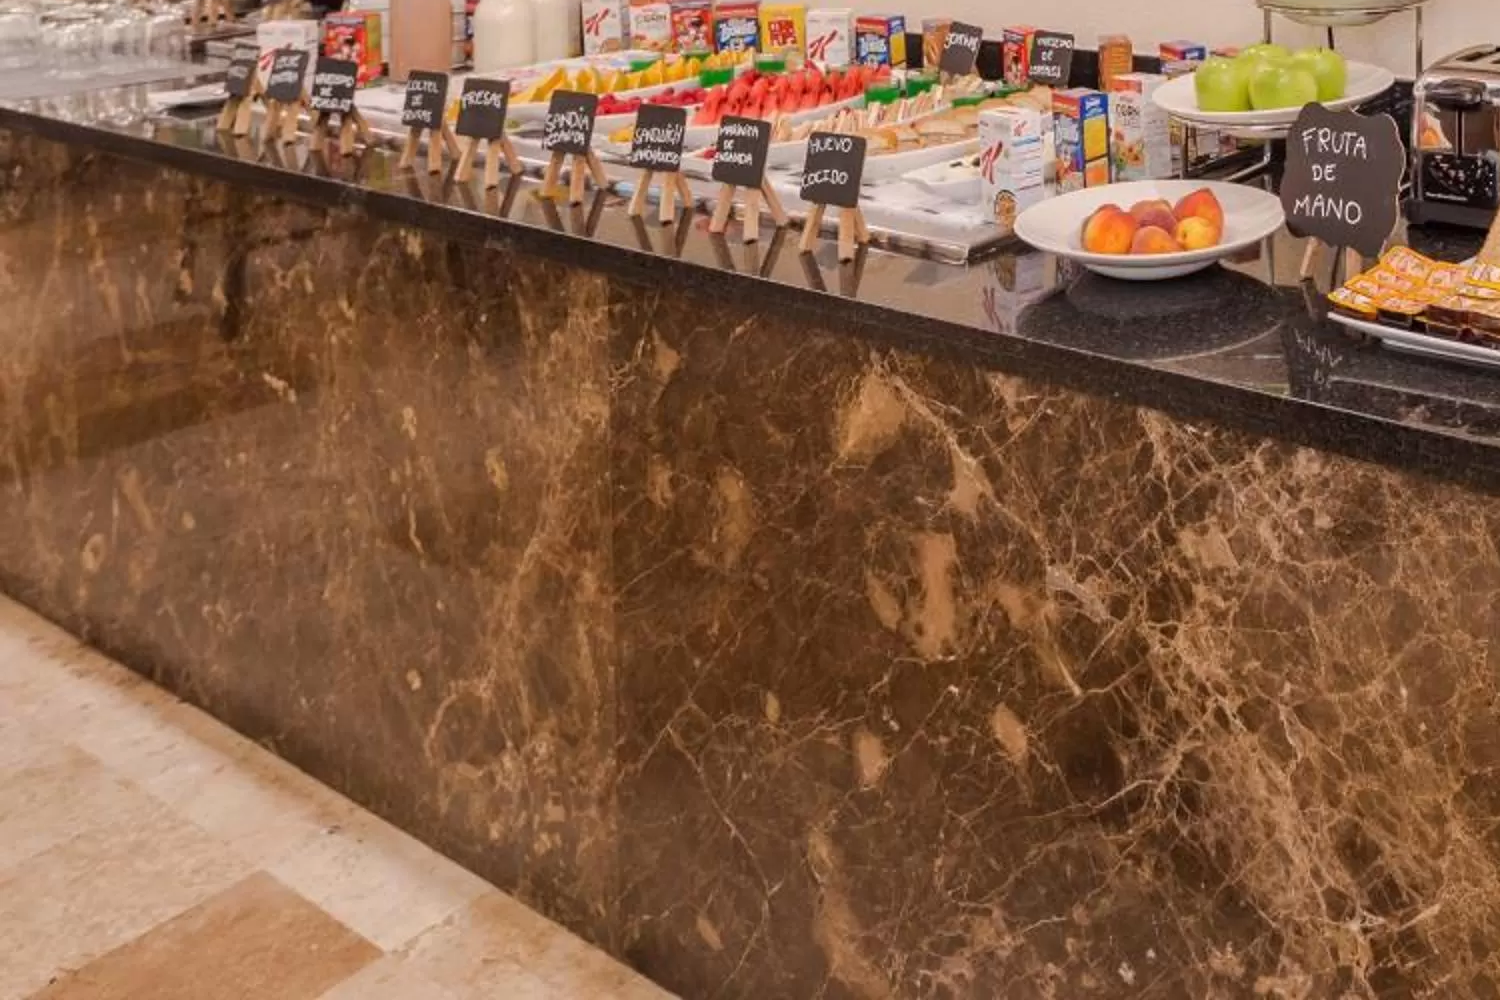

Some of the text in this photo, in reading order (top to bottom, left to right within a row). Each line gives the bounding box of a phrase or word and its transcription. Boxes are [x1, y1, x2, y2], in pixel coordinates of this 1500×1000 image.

[809, 137, 853, 155] HUEVO
[1301, 127, 1367, 160] FRUTA
[801, 169, 849, 188] COCIDO
[1311, 163, 1338, 181] DE
[1292, 193, 1362, 225] MANO
